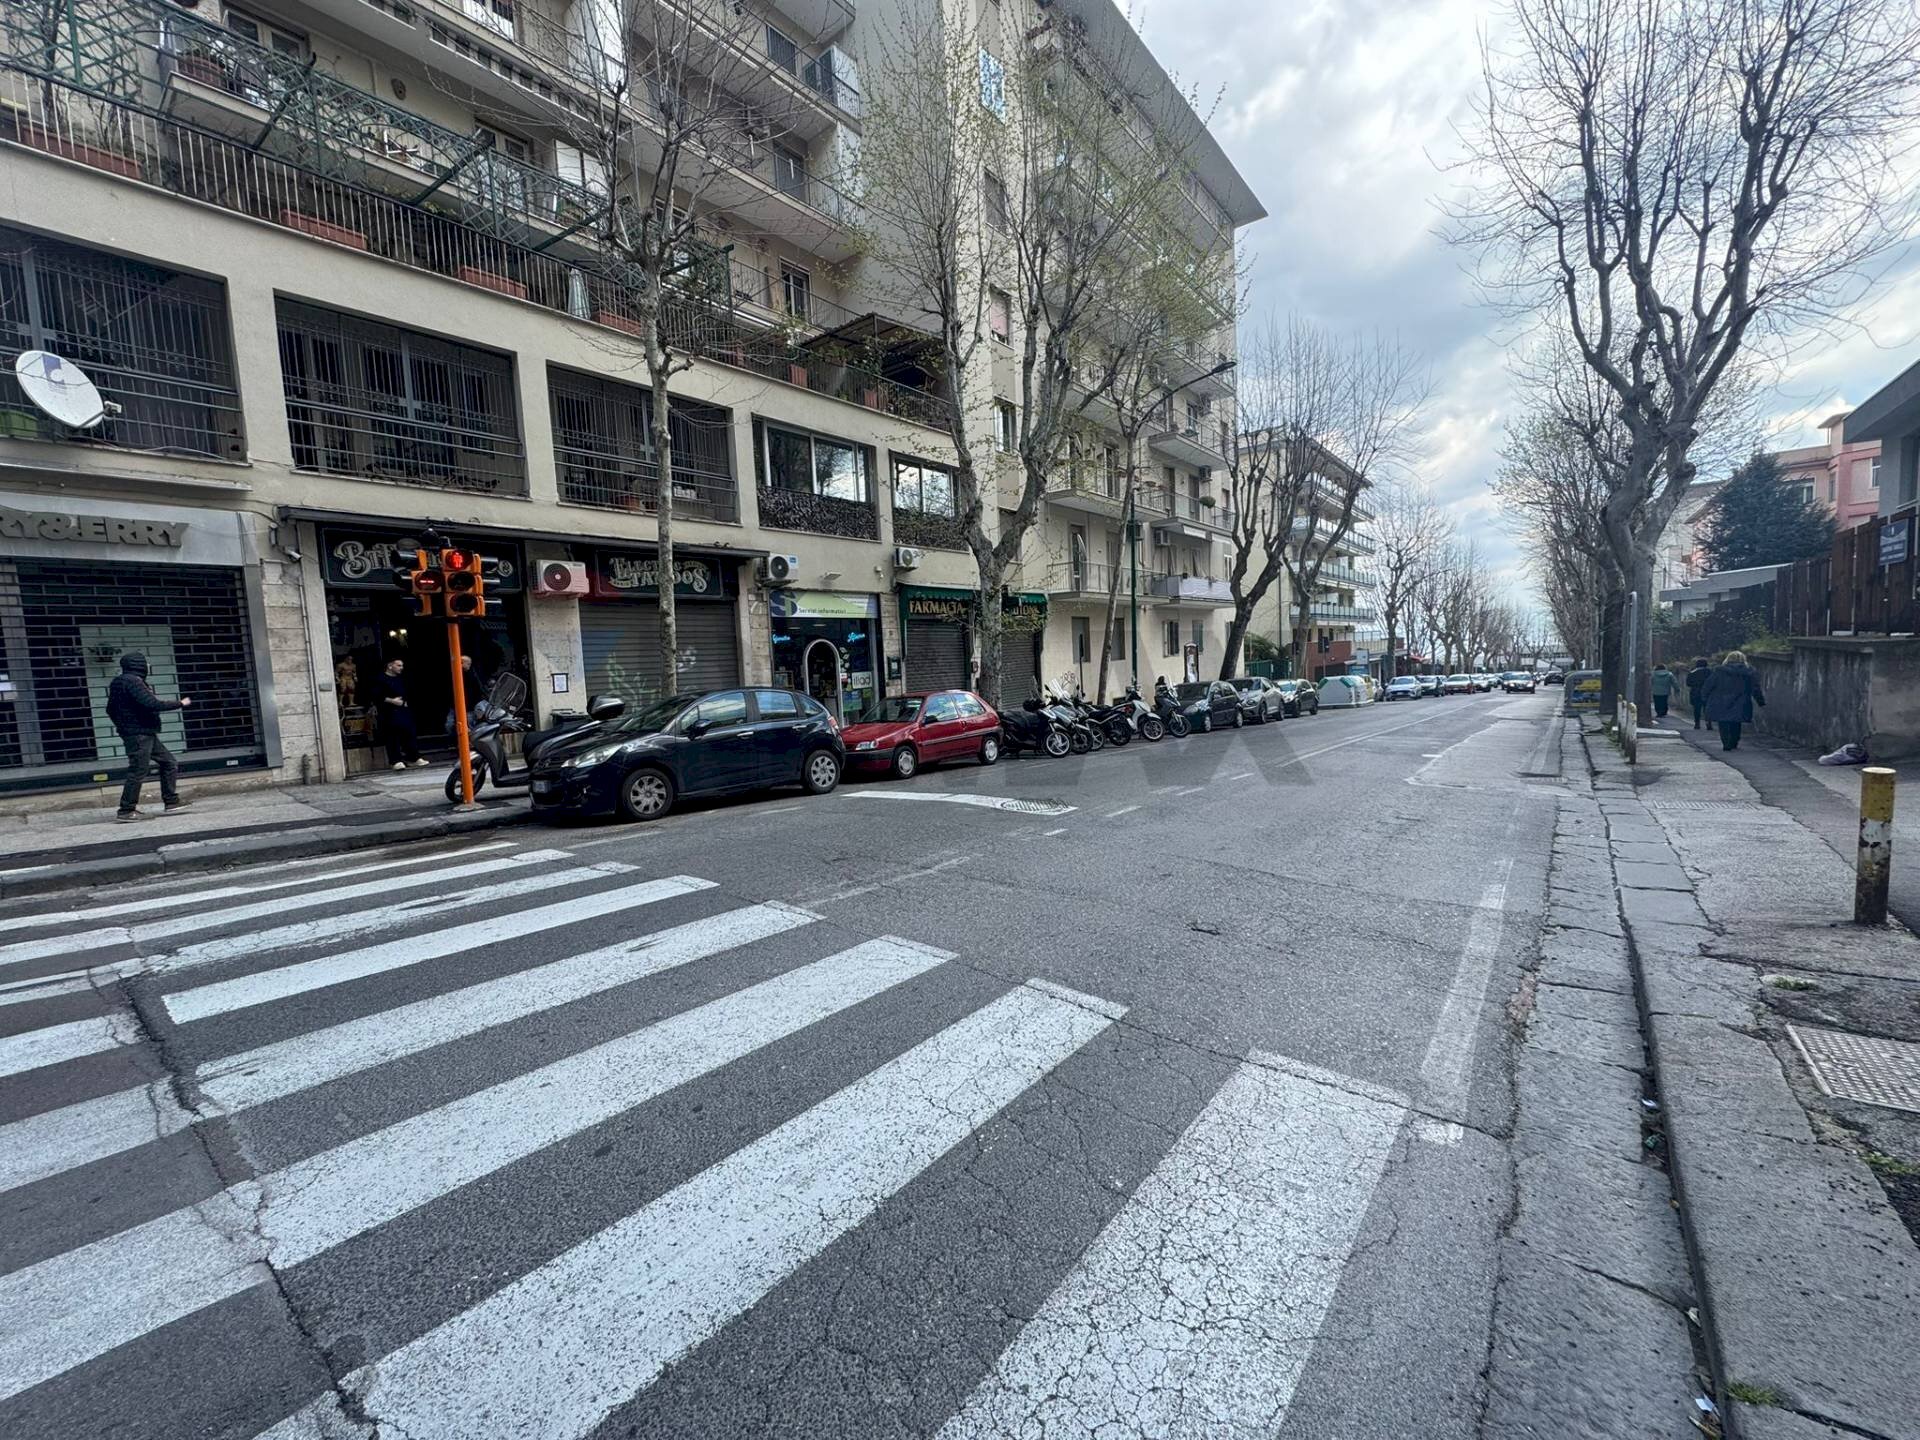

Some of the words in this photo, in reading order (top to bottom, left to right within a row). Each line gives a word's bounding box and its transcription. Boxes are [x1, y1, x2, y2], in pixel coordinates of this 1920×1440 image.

[609, 557, 683, 579] ELECTC
[631, 568, 708, 593] TAOOS
[909, 600, 964, 614] FARMACIA
